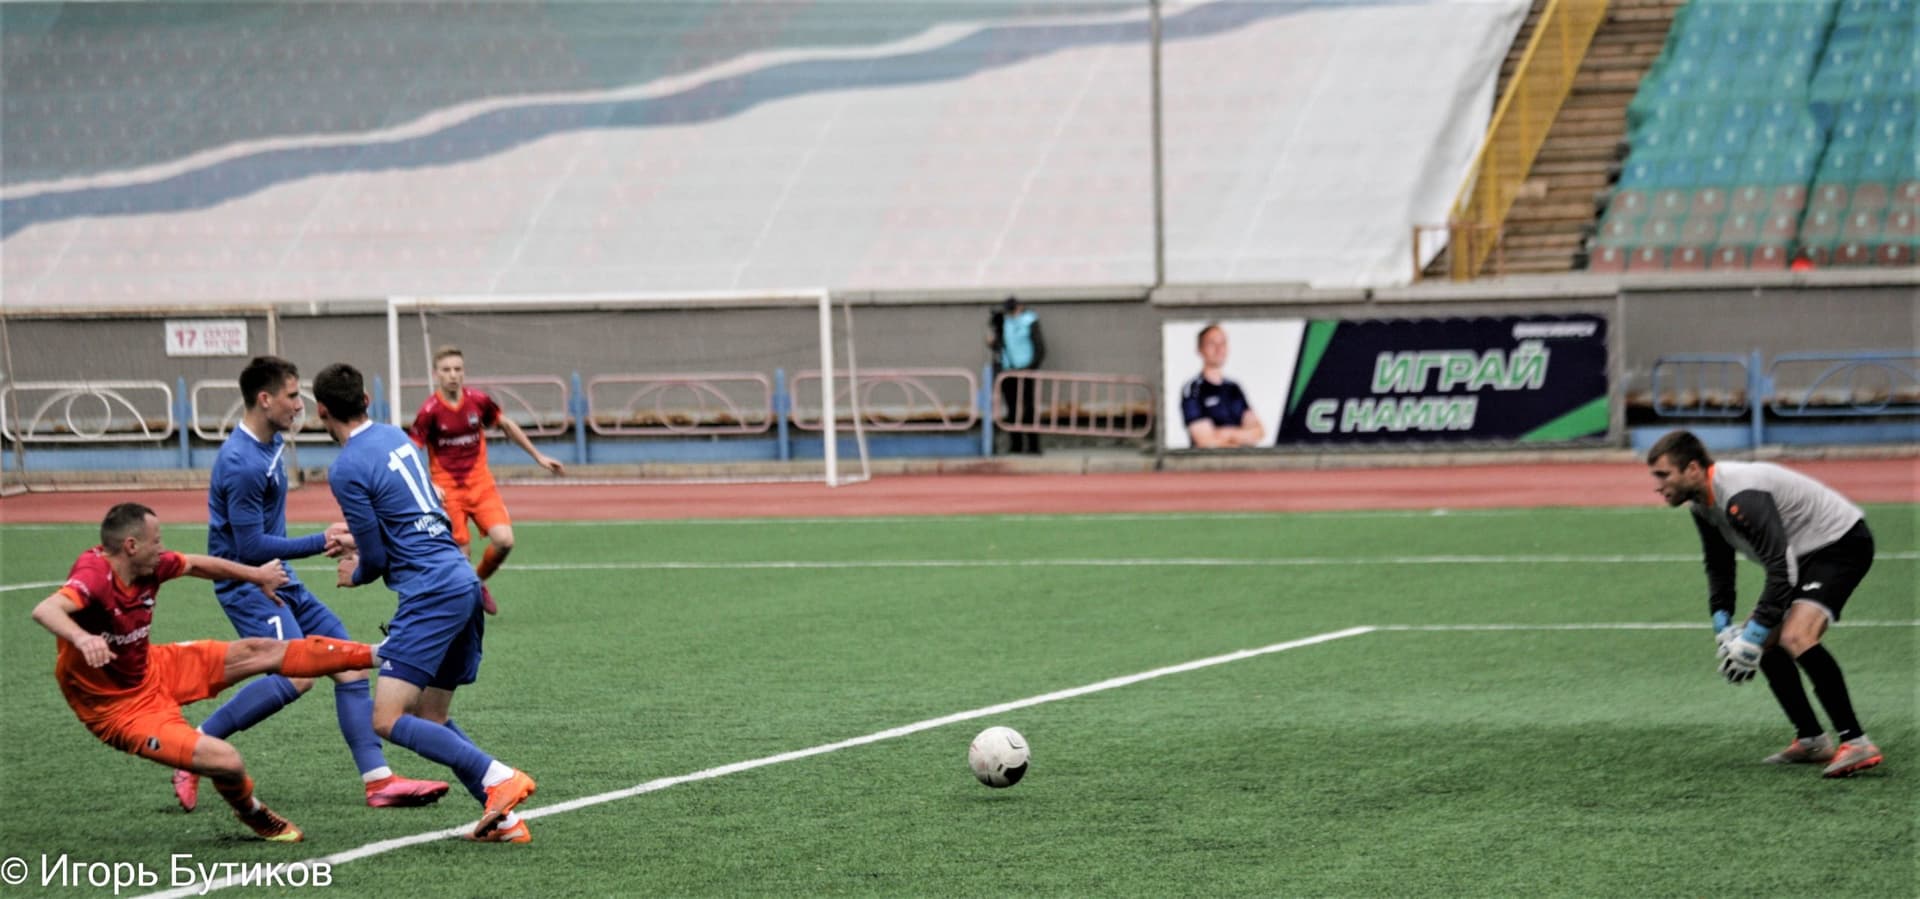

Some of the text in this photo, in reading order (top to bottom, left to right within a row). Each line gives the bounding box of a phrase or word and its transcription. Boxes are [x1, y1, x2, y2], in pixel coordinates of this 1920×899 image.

[175, 329, 197, 348] 17
[1371, 340, 1550, 394] ИГРАЙ
[387, 443, 438, 513] 17
